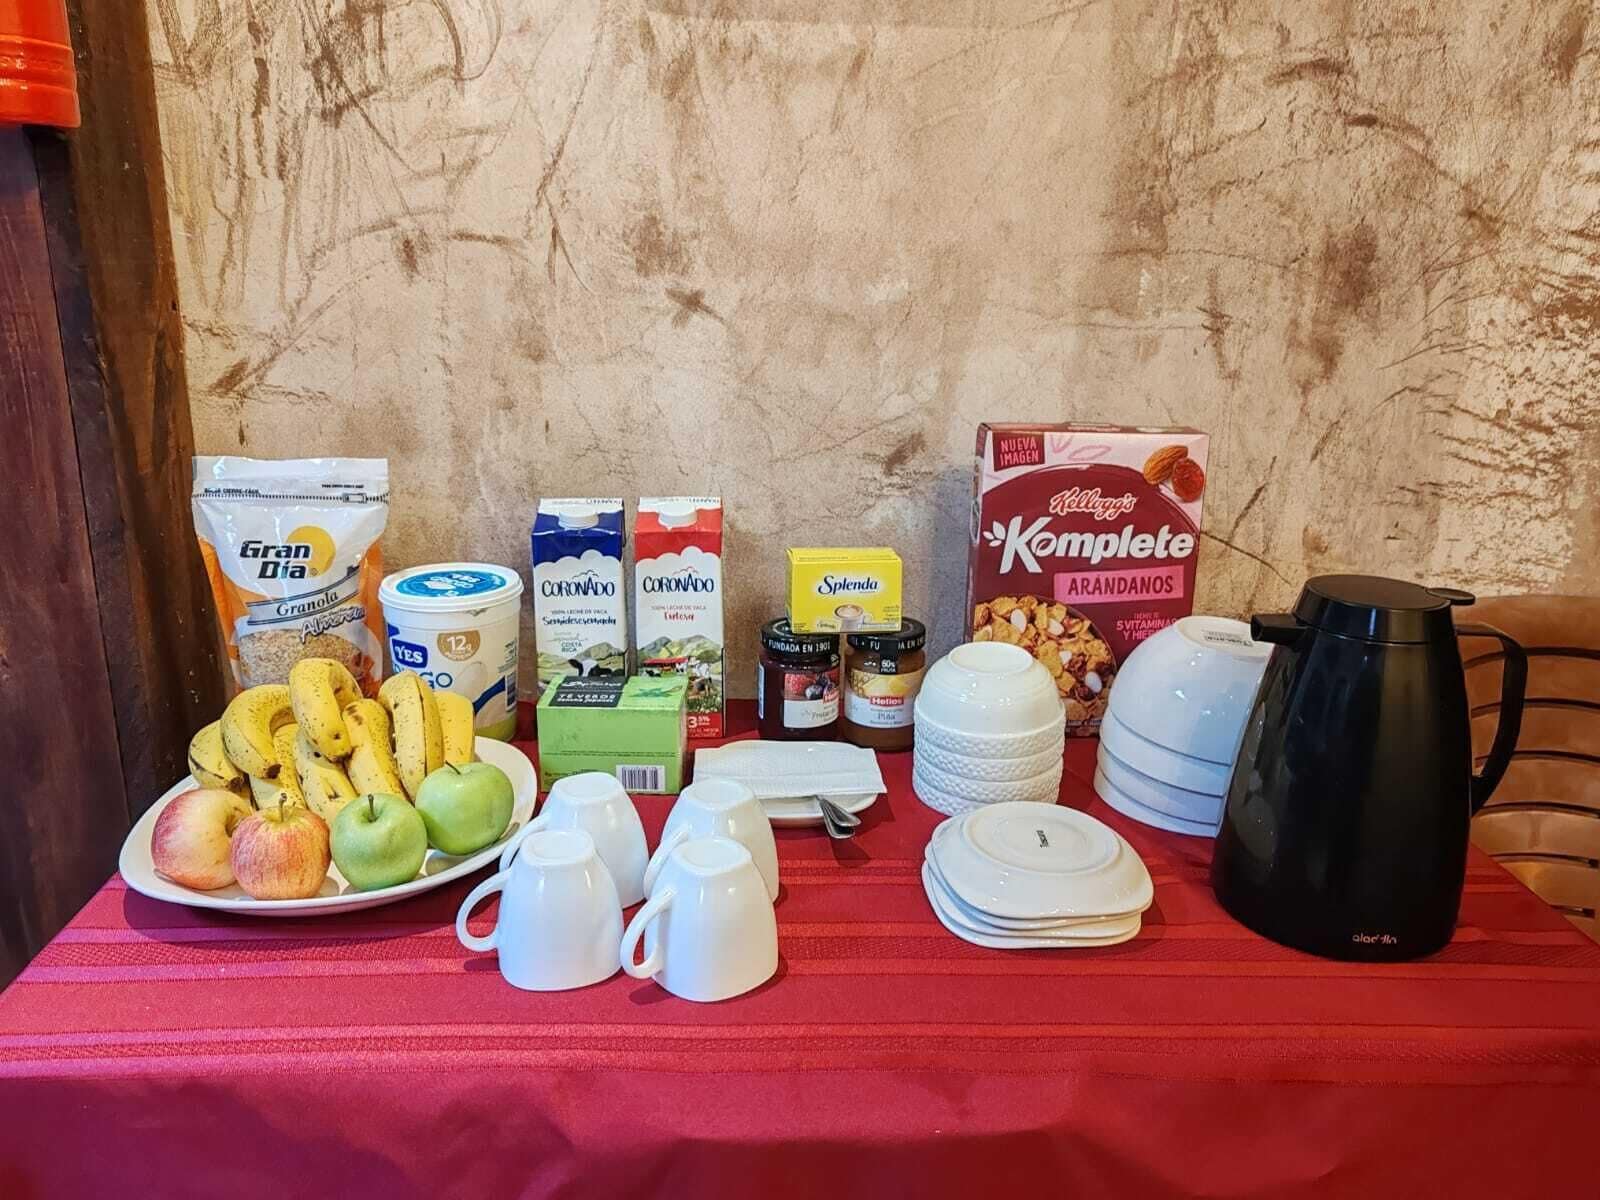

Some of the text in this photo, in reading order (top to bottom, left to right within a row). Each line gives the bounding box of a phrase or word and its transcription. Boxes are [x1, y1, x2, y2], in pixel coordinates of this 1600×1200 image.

[1001, 437, 1037, 451] NUEVA
[1000, 452, 1039, 466] IMAGEN
[1050, 486, 1137, 521] Kellogg's
[239, 540, 311, 559] Gran
[1000, 516, 1194, 574] Komplete
[541, 576, 616, 597] CORONADO
[642, 573, 715, 594] CORONADO
[817, 575, 878, 596] Splenda
[1068, 574, 1174, 597] ARÁNDANOS
[276, 591, 338, 616] Granola
[1116, 620, 1123, 631] 5
[1123, 630, 1130, 640] Y
[395, 646, 424, 663] YES
[768, 638, 831, 653] FUNDADA EN 1901
[871, 697, 902, 706] Helios
[688, 716, 698, 729] 3
